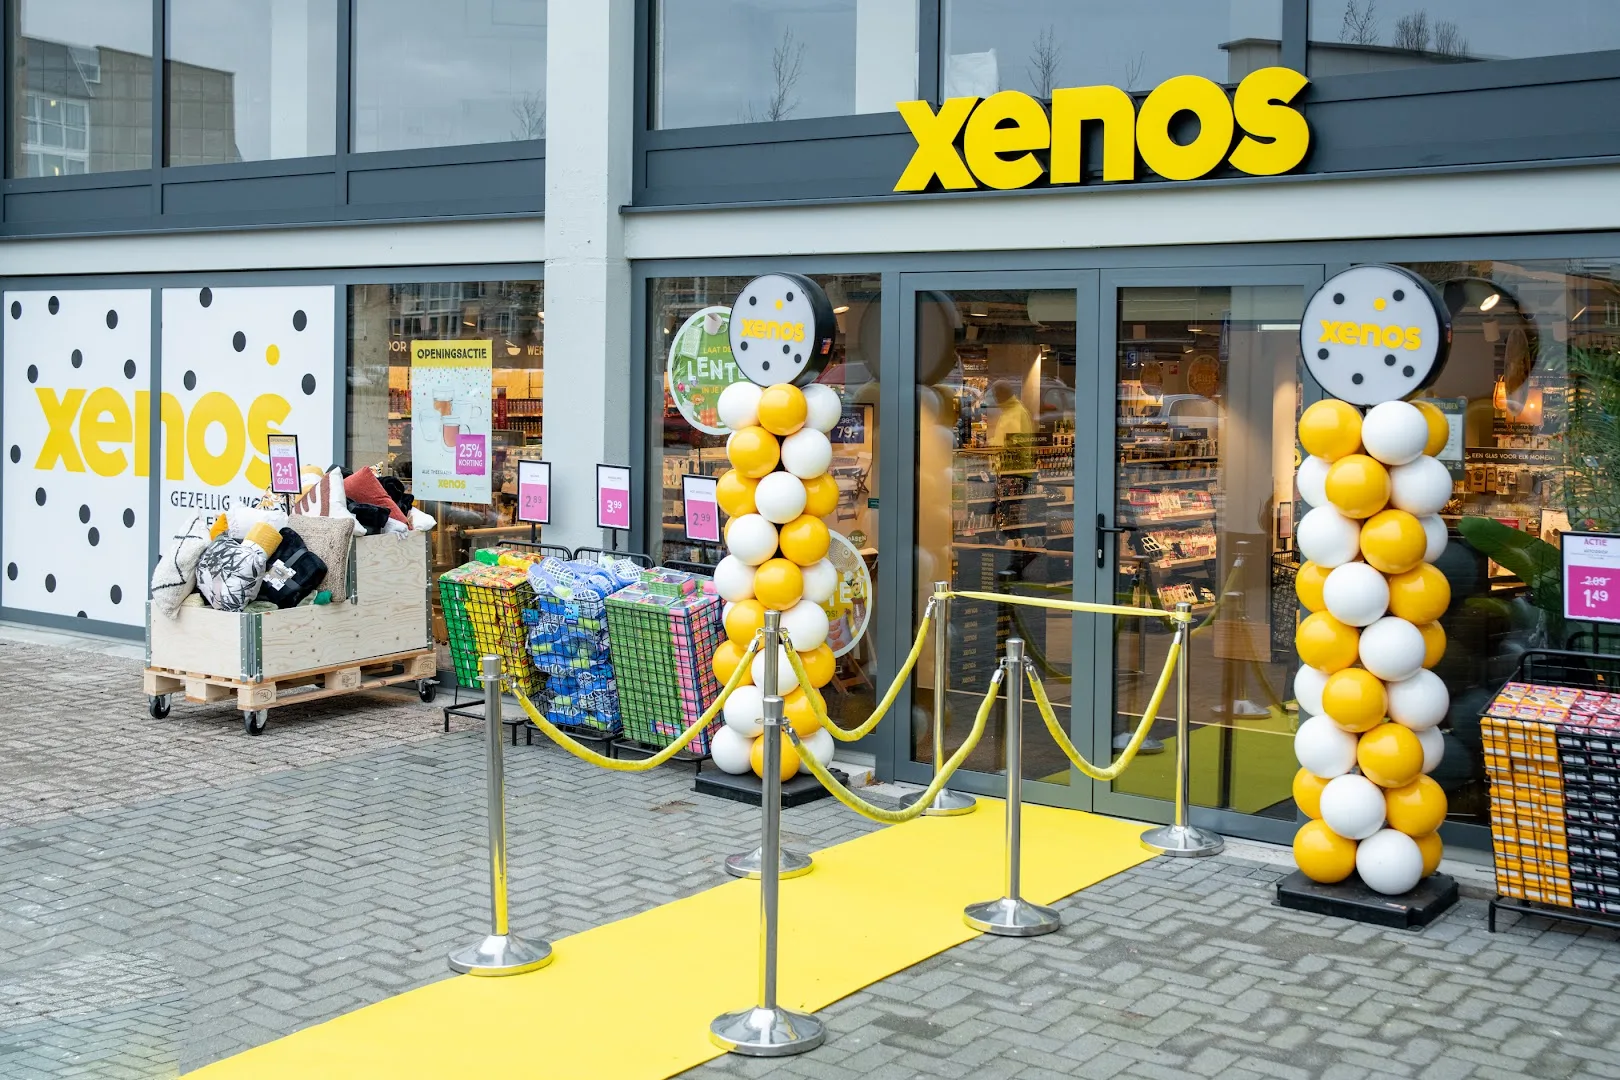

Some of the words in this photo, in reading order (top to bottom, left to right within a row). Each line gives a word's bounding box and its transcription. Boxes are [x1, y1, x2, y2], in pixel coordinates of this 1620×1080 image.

[893, 67, 1311, 193] xenos
[741, 318, 805, 342] xenos
[1318, 319, 1422, 351] xenos
[417, 348, 487, 359] OPENINGSACTIE
[703, 346, 721, 354] LAAT
[34, 387, 292, 491] xenos
[459, 443, 482, 458] 25%
[276, 462, 293, 477] 2+1
[458, 459, 483, 467] KORTING
[438, 479, 466, 489] xenos
[171, 490, 230, 511] GEZELLIG
[606, 499, 622, 513] 3.99
[692, 512, 711, 526] 2.99
[1584, 537, 1608, 546] ACTIE
[1583, 589, 1609, 608] 1.49
